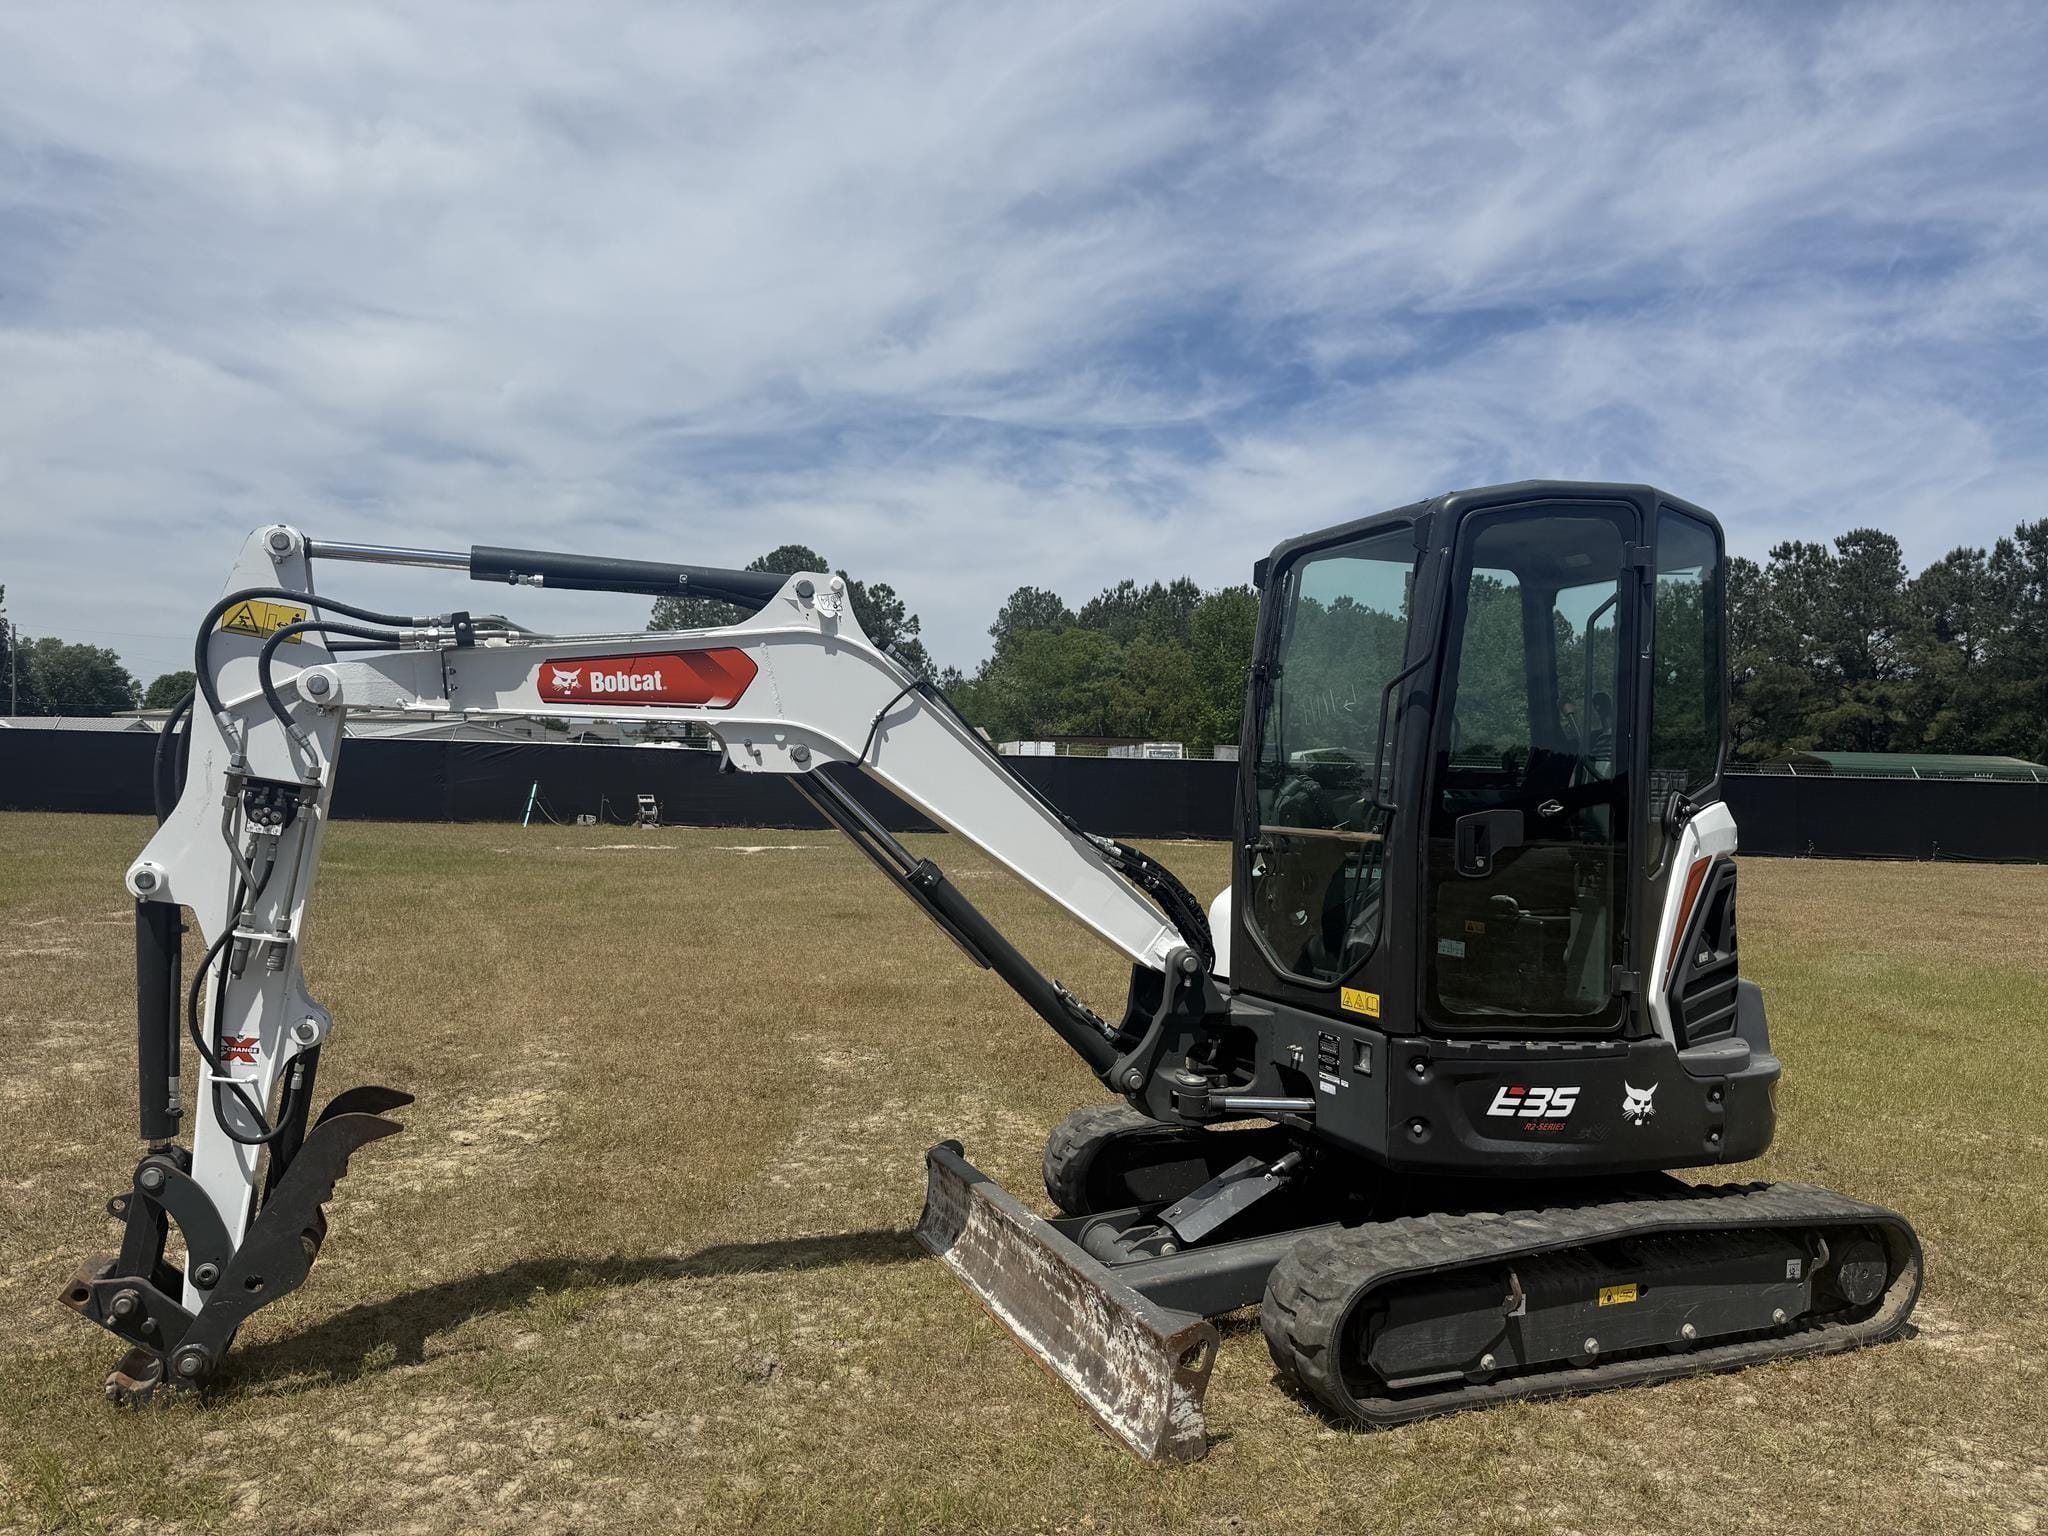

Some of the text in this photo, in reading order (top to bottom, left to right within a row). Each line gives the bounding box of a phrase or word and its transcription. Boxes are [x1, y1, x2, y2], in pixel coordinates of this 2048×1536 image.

[589, 670, 663, 693] Bobcat
[1486, 1086, 1581, 1118] E35
[1524, 1122, 1566, 1131] R2-SERIES
